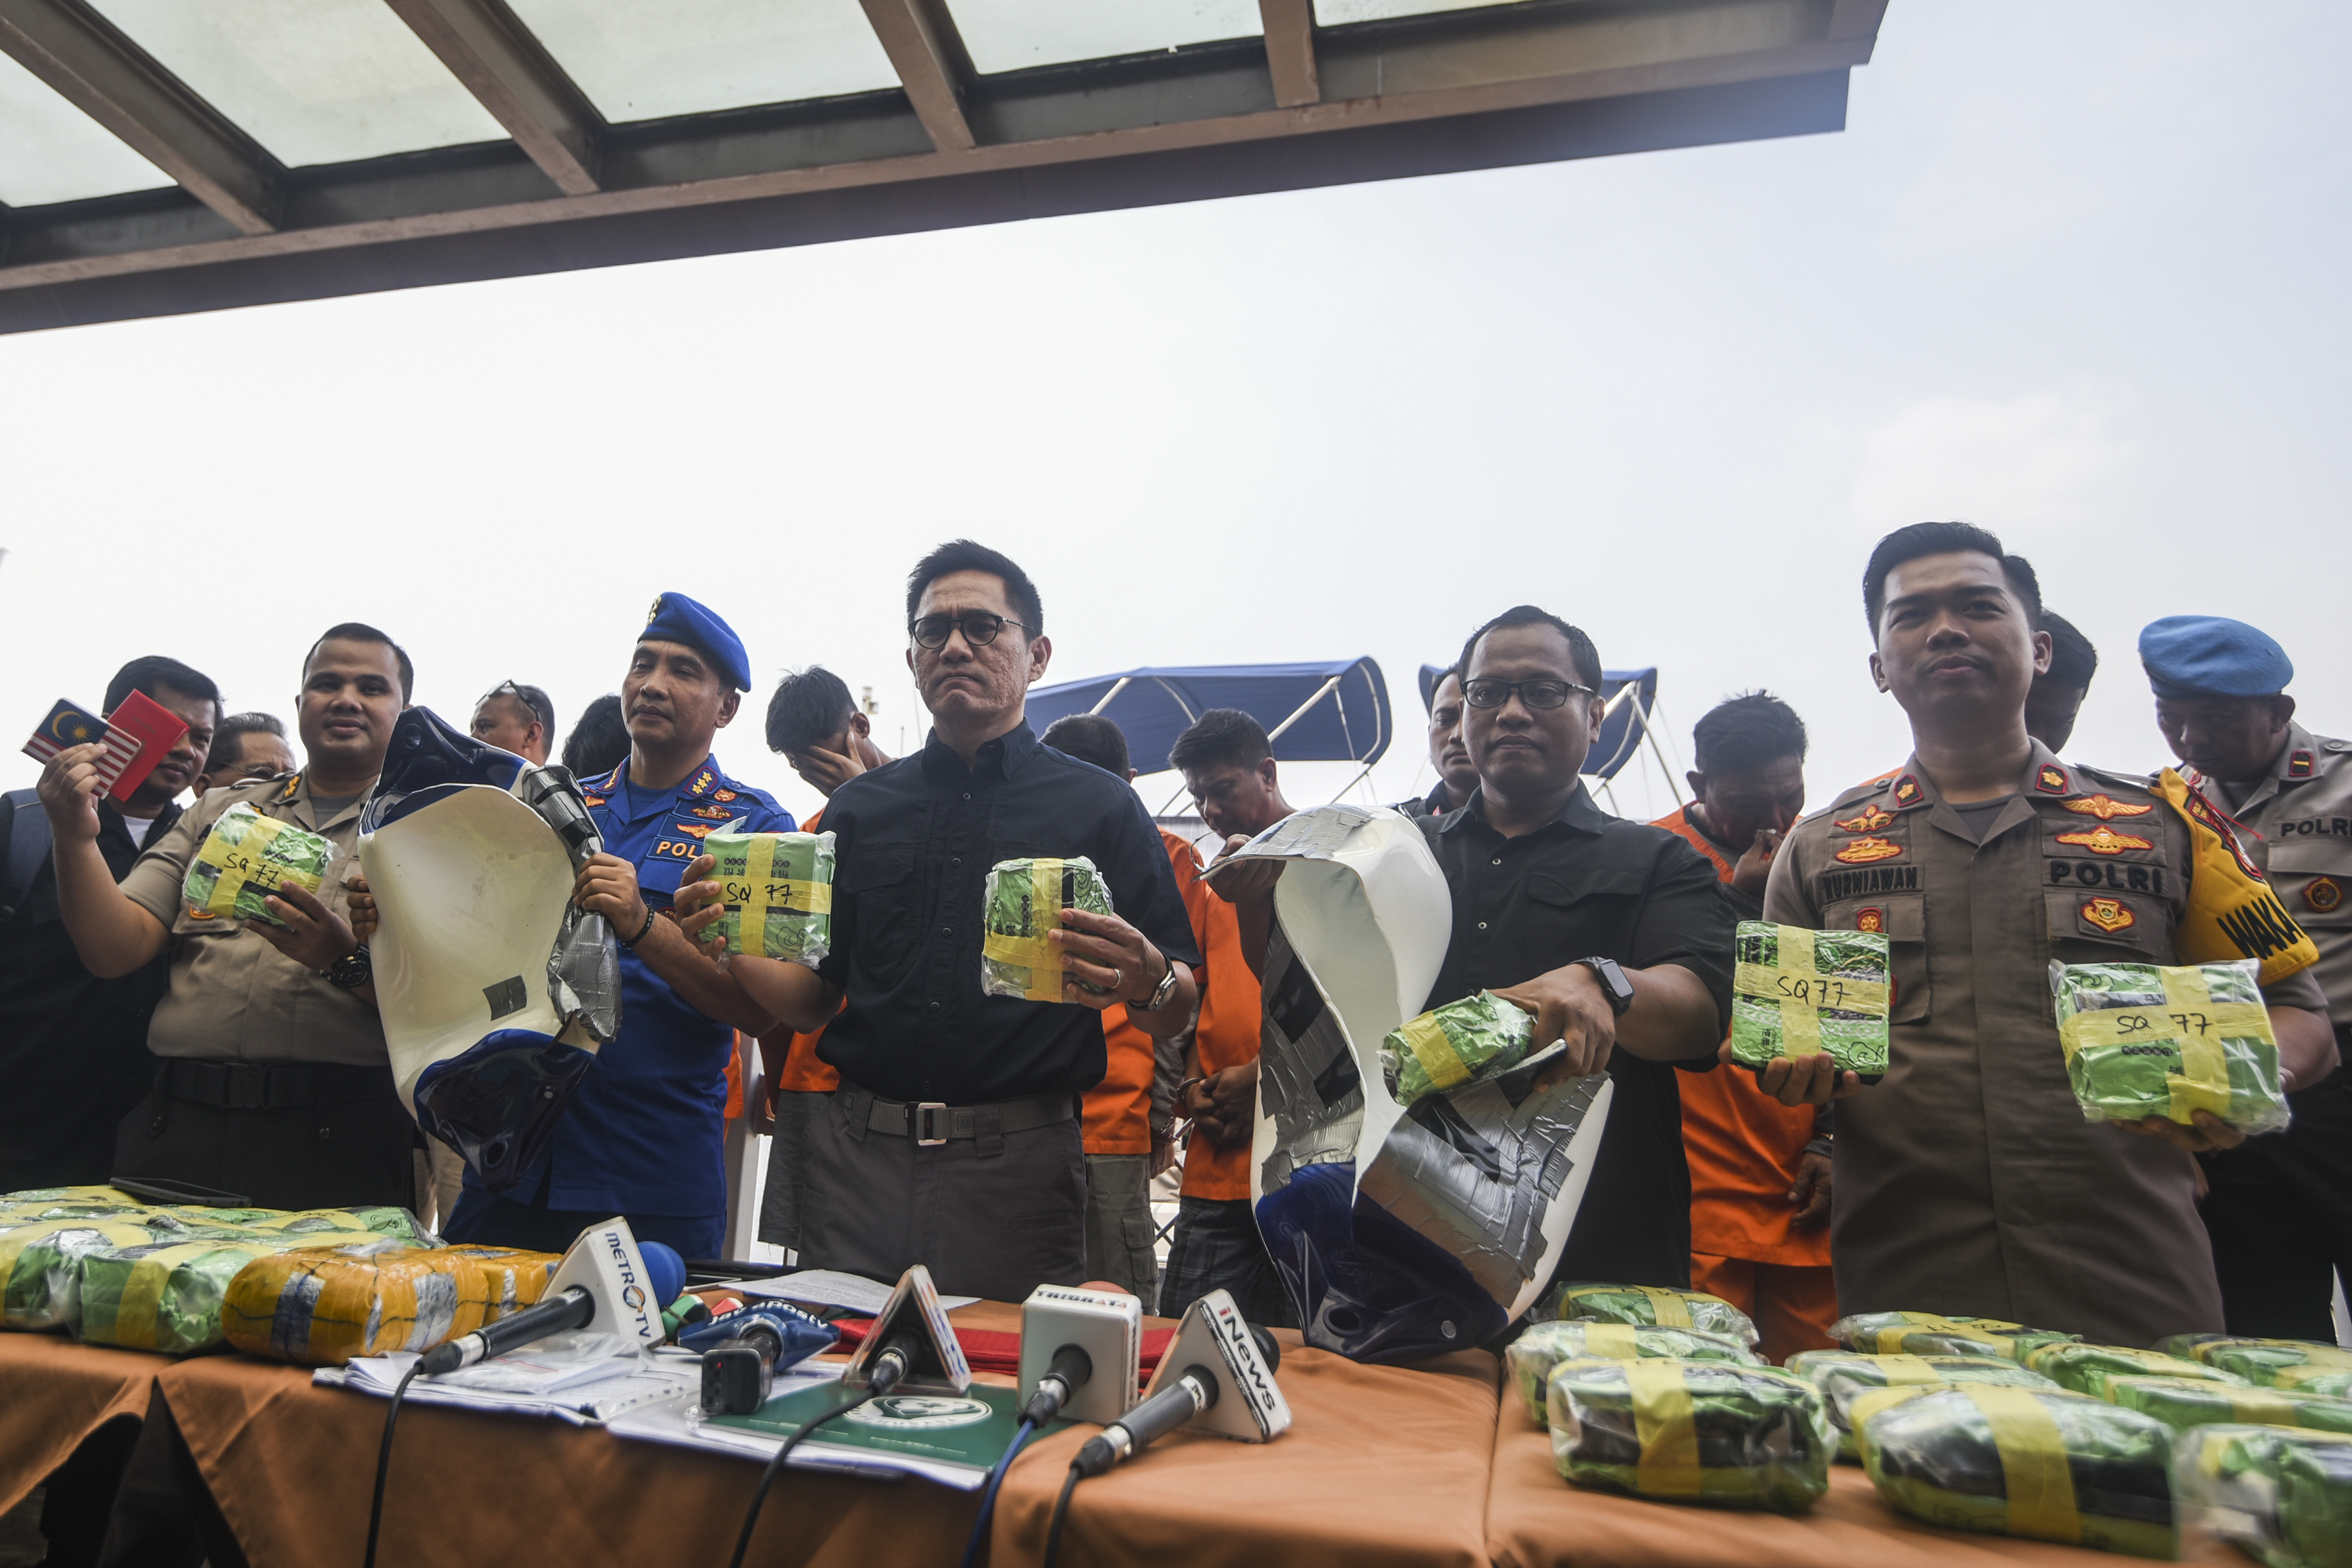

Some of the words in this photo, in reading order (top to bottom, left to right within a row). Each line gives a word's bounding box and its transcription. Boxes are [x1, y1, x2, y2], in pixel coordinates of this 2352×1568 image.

[256, 864, 279, 888] 77
[1823, 867, 1917, 901] KURNIAWAN
[2050, 860, 2161, 893] POLRI
[727, 882, 751, 904] SQ
[764, 884, 792, 904] 77
[2216, 892, 2304, 961] WAKA
[1777, 976, 1809, 1005] SQ
[1813, 980, 1852, 1006] 77
[2117, 1015, 2153, 1034] SQ
[2169, 1013, 2213, 1036] 77
[636, 1312, 652, 1338] TV
[1218, 1306, 1275, 1410] iNews
